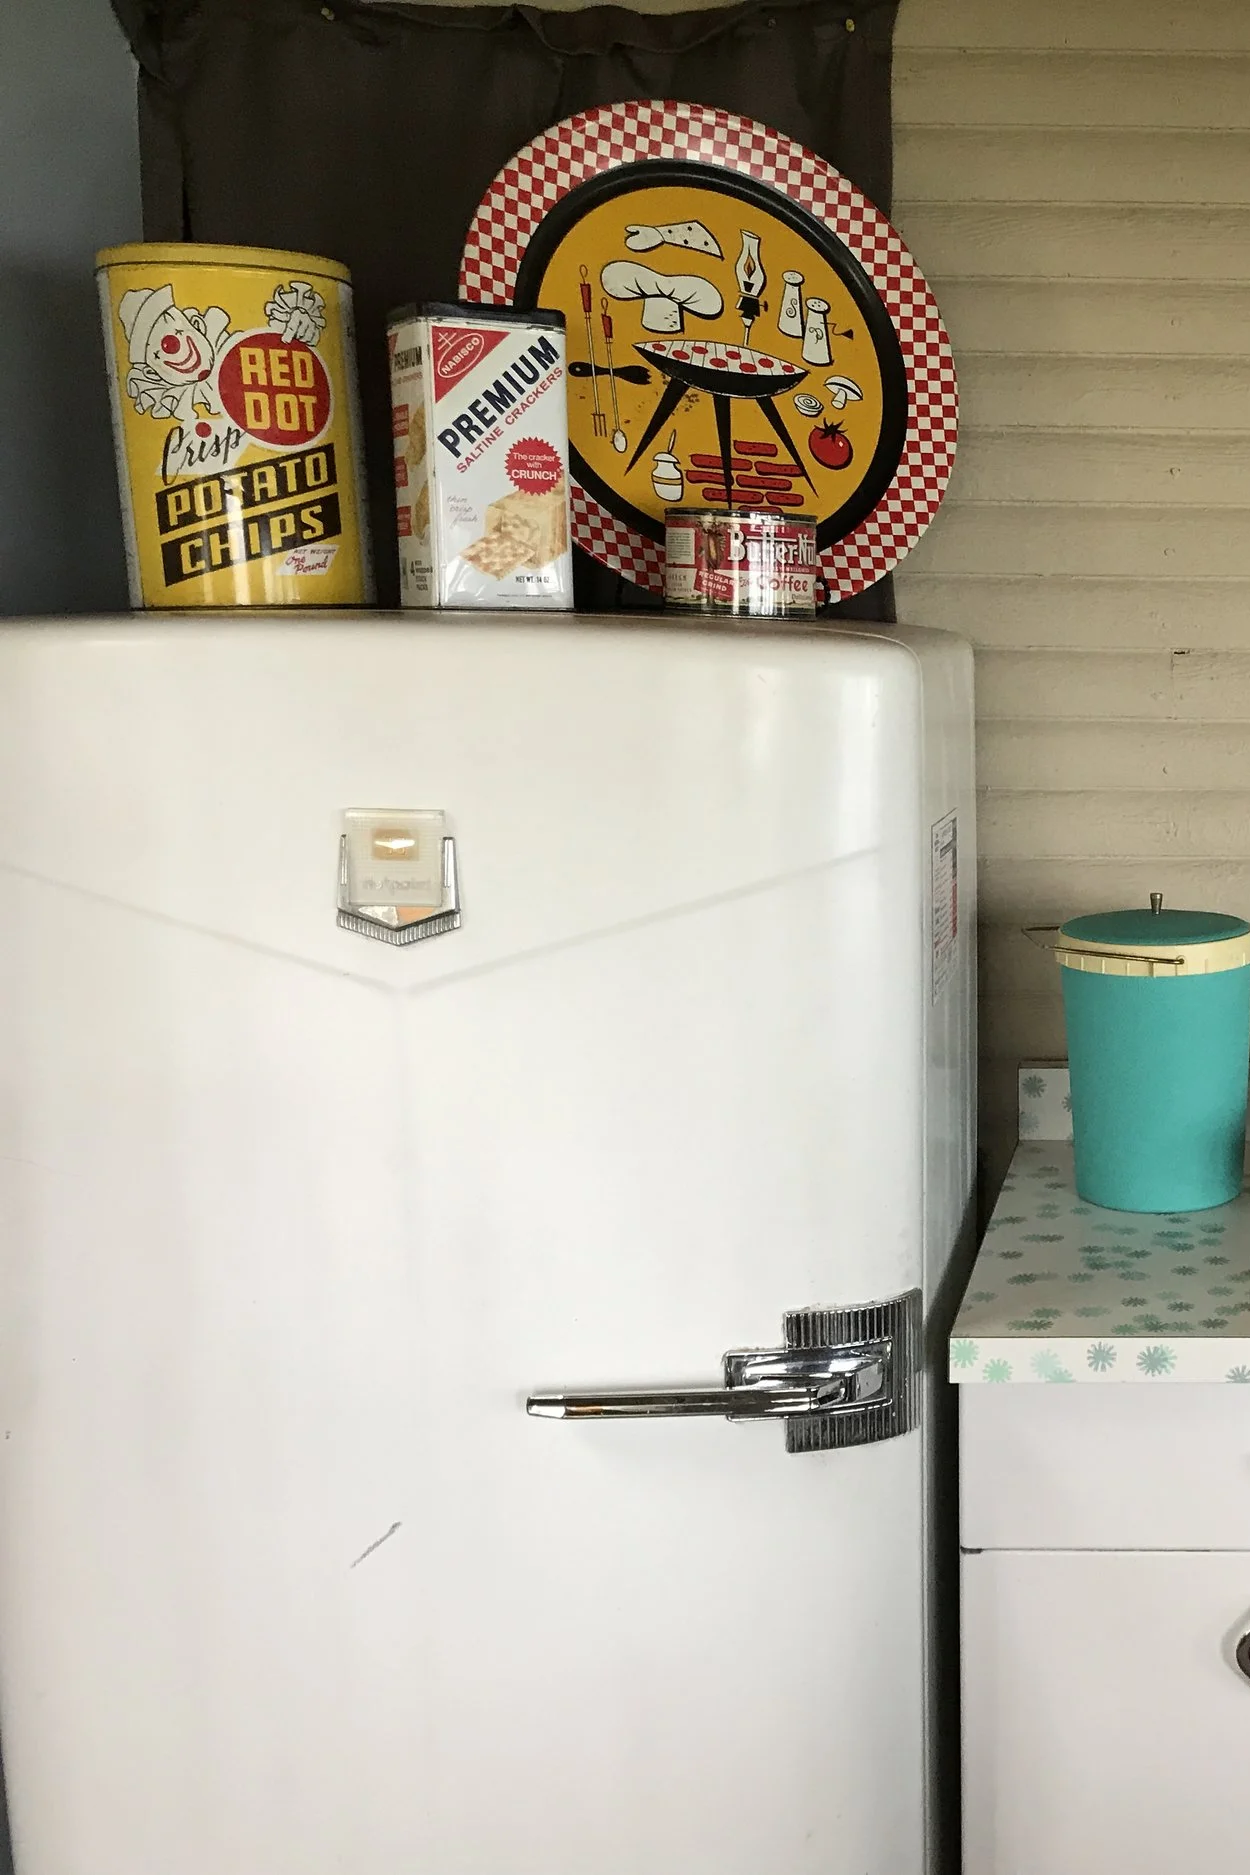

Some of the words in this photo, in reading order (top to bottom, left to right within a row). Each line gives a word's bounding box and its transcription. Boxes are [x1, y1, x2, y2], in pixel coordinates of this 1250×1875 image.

[240, 346, 315, 389] RED
[441, 336, 481, 375] NABISCO
[244, 391, 318, 433] DOT
[437, 335, 561, 459] PREMIUM
[456, 425, 505, 474] SALTINE
[504, 366, 564, 426] CRACKERS
[161, 425, 247, 486] Crisp
[511, 469, 557, 480] CRUNCH
[513, 452, 528, 461] The
[528, 454, 556, 462] cracker
[166, 451, 329, 527] POTATO
[180, 504, 325, 574] CHIPS
[294, 554, 329, 575] Pound
[702, 580, 728, 592] GRIND
